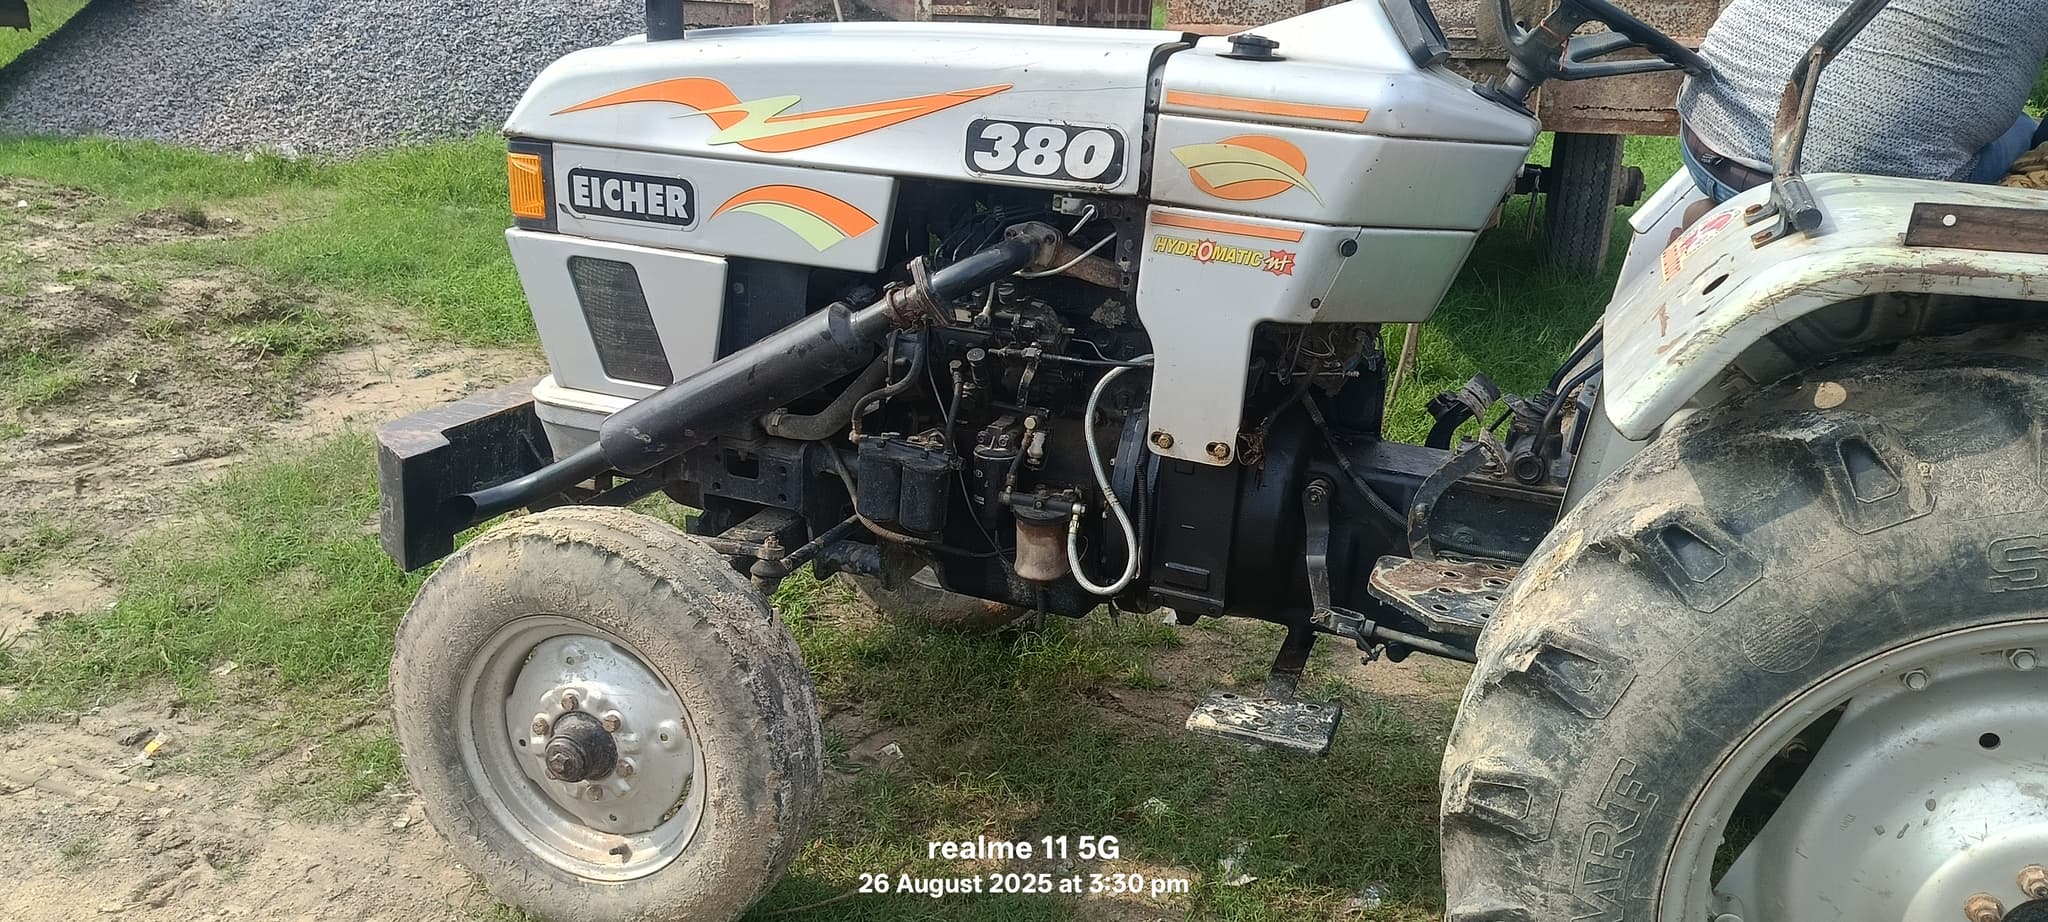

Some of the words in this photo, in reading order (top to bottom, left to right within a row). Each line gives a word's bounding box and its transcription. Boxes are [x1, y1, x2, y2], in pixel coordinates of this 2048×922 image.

[973, 122, 1116, 180] 380
[572, 174, 689, 219] EICHER
[1153, 235, 1264, 268] HYDROMATIC
